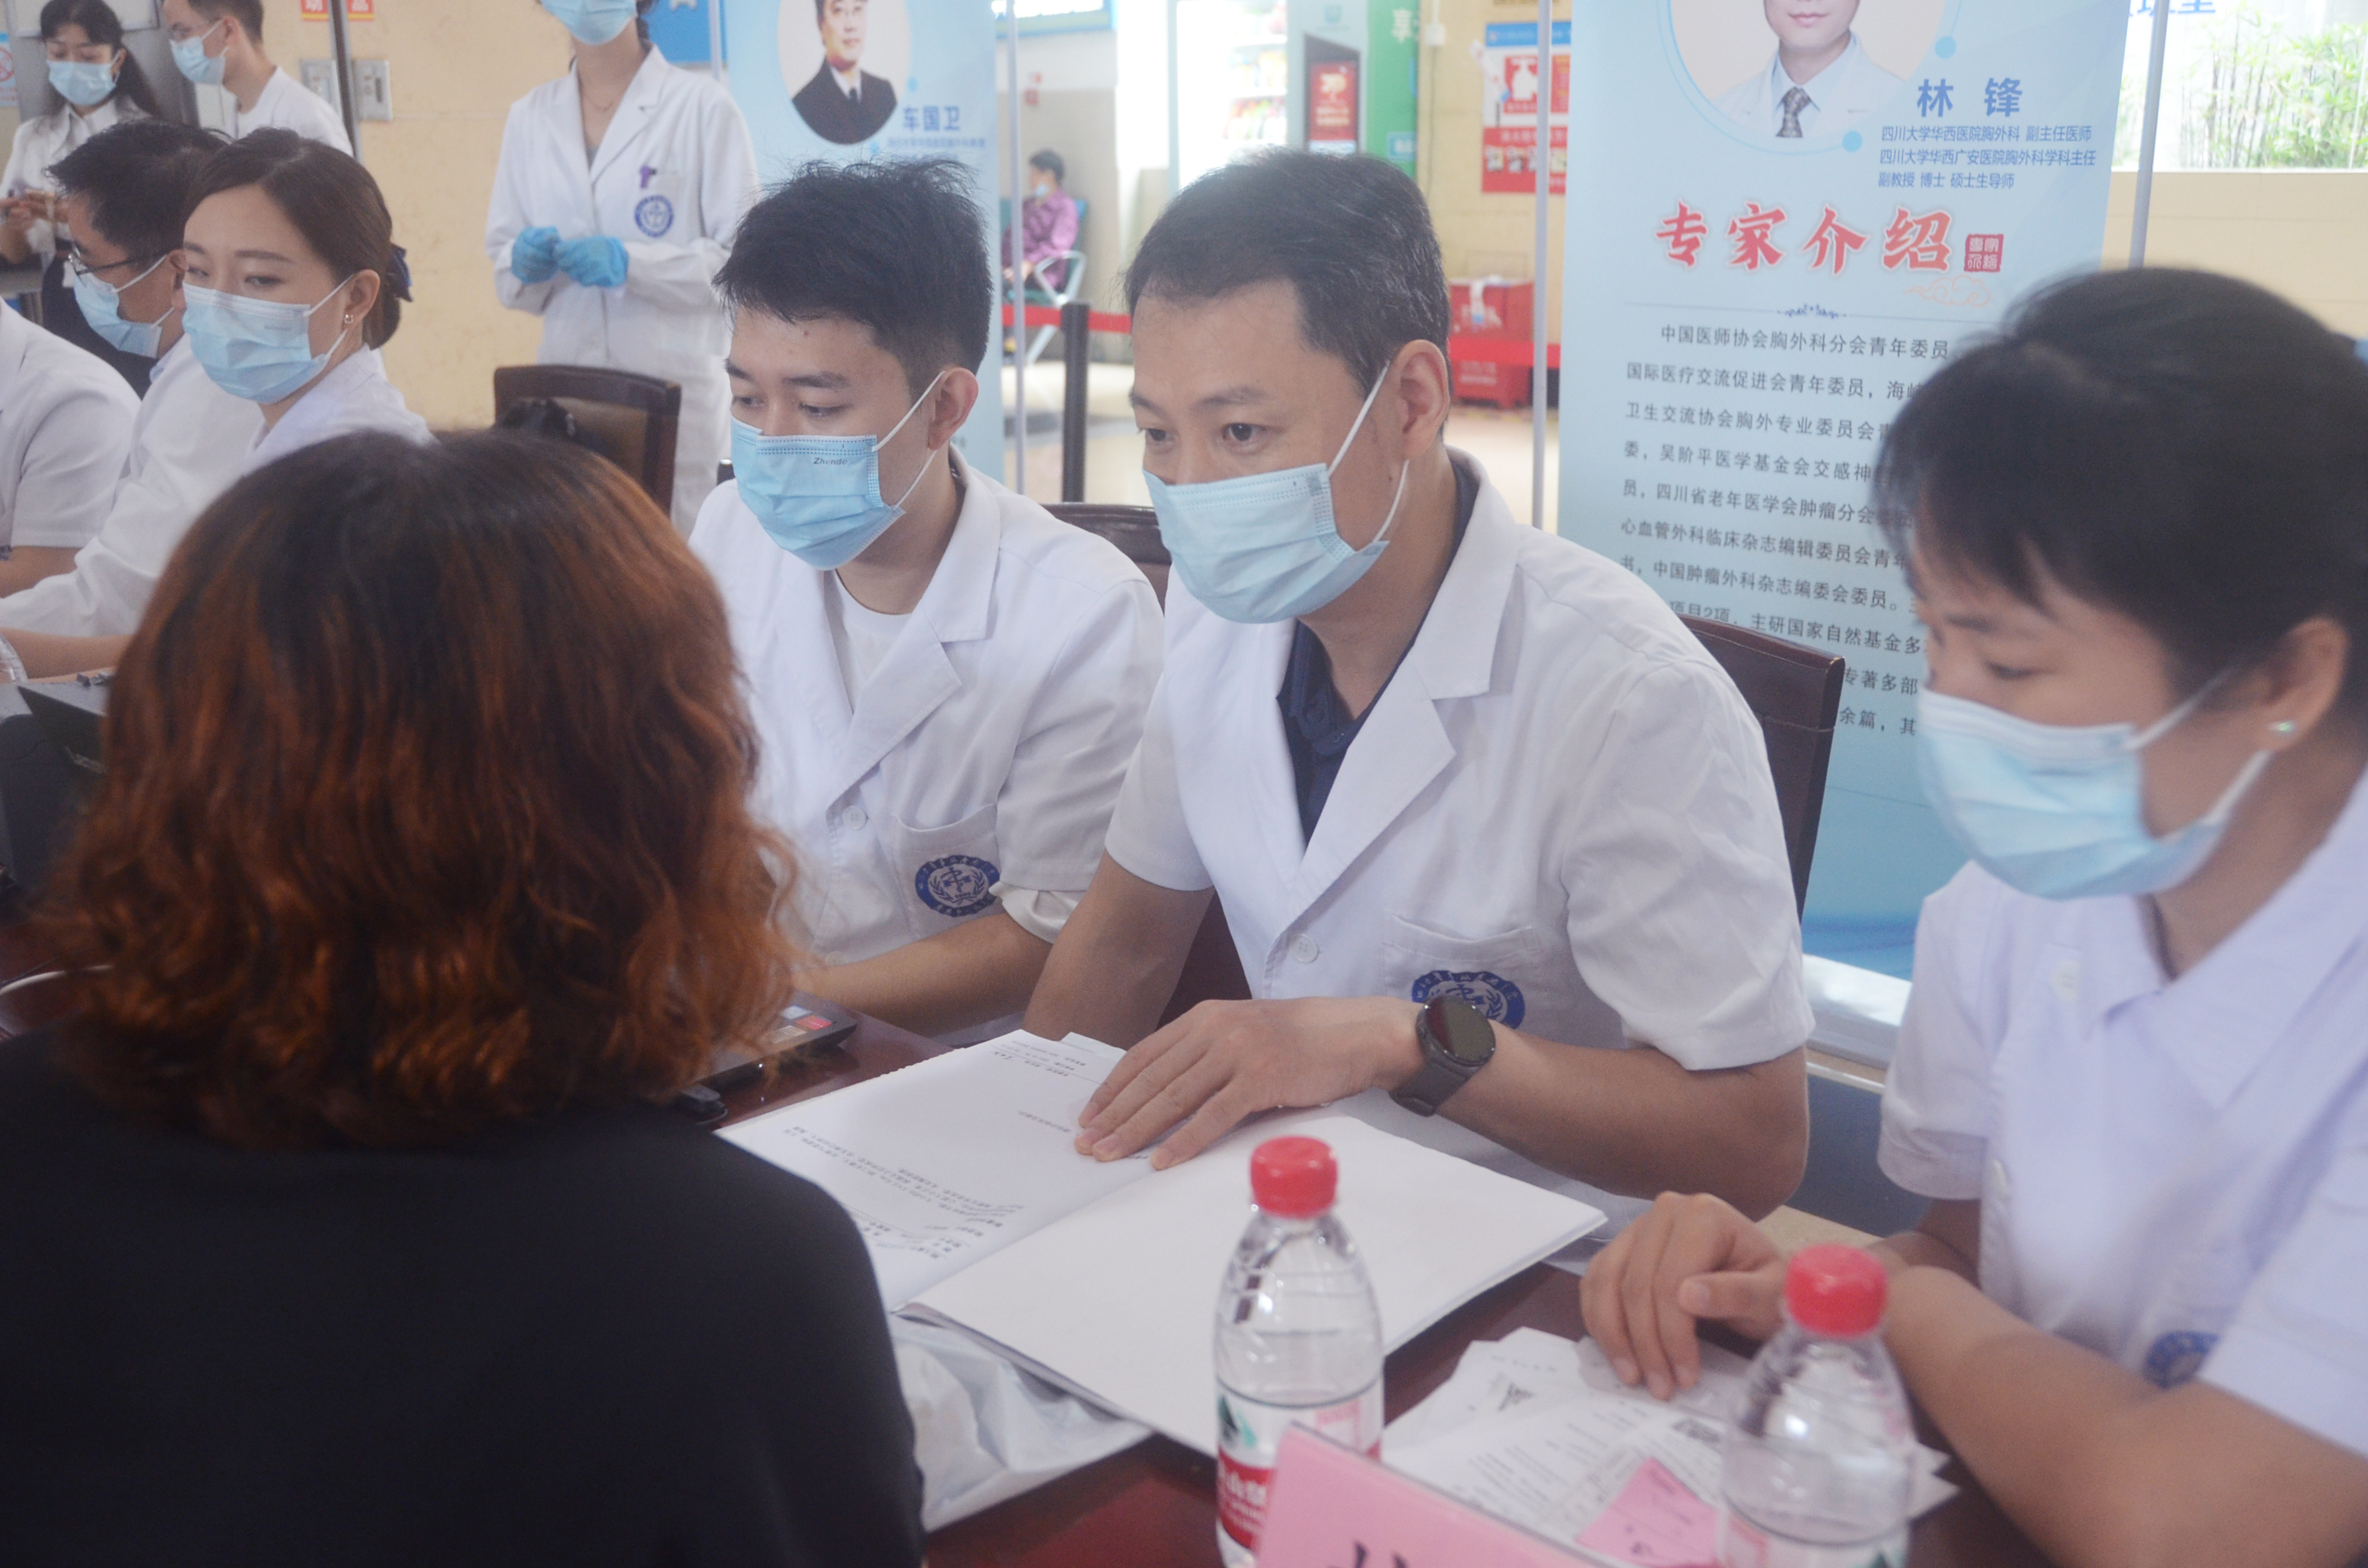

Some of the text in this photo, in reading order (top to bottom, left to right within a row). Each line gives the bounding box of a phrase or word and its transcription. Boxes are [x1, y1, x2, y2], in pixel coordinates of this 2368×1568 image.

[1917, 78, 2023, 117] 林锋
[1882, 126, 2093, 142] 四川大学华西医院胸外科 副主任医师
[1880, 149, 2096, 166] 四川大学华西广安医院胸外科学科主任
[1878, 171, 2015, 189] 副教授 博士 硕士生导师
[1656, 199, 1952, 275] 专家介绍
[1845, 666, 1918, 696] 专著多部
[1839, 706, 1917, 736] 余篇，其
